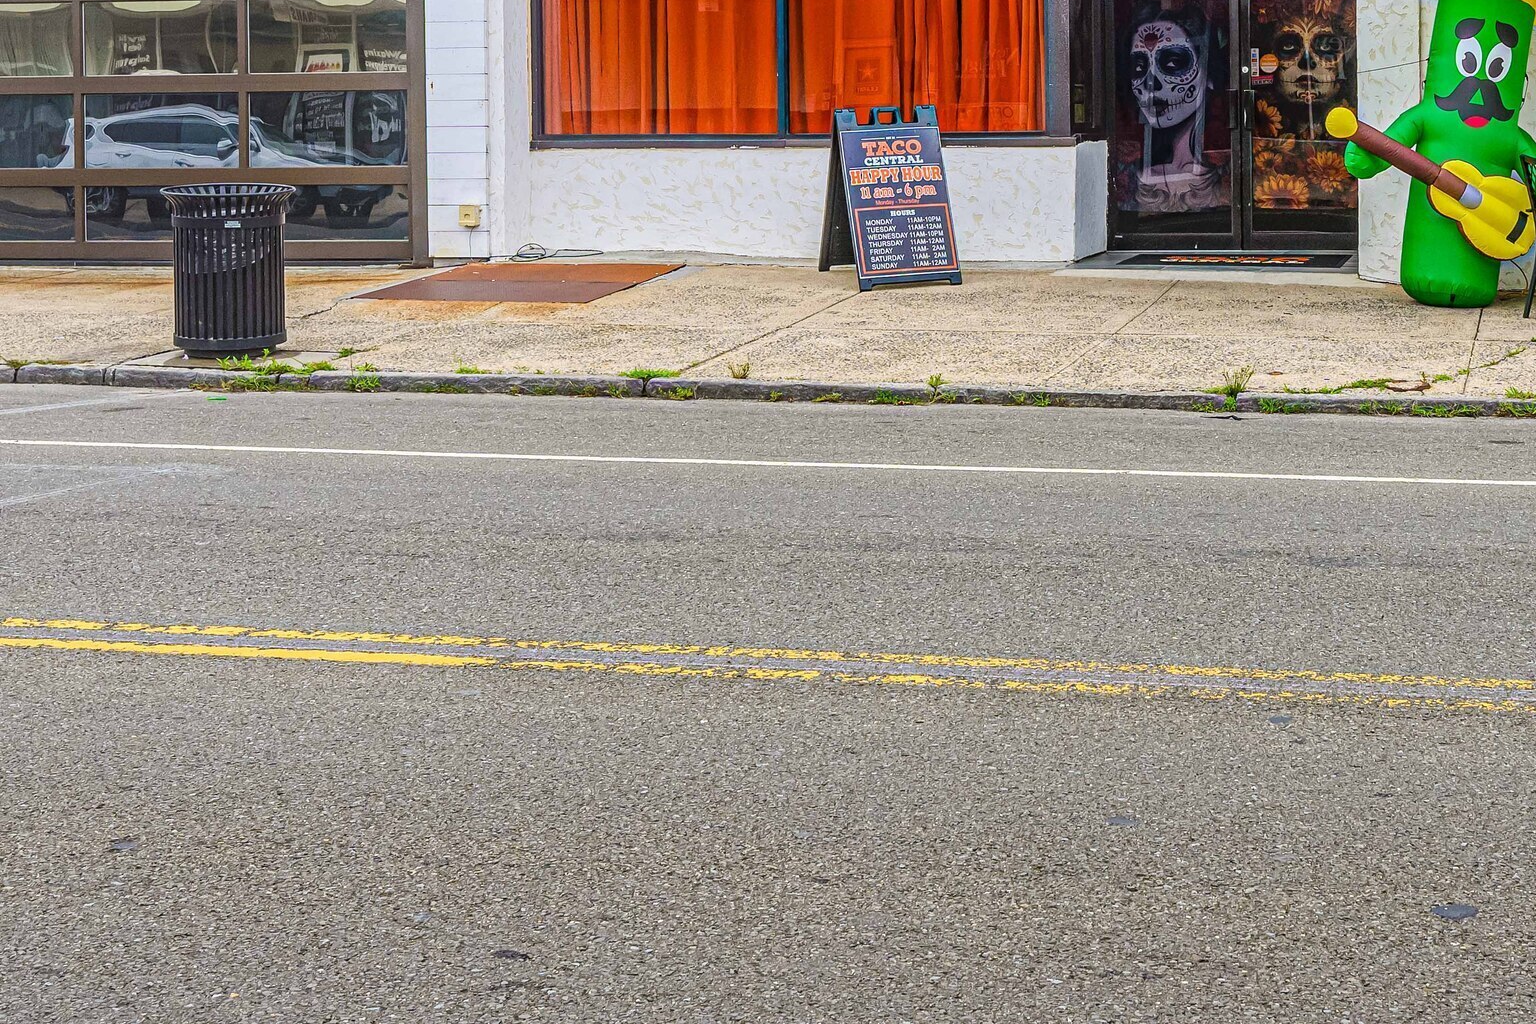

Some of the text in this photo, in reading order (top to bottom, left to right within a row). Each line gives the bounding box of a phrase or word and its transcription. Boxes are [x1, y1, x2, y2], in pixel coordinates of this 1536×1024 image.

[861, 138, 922, 157] TACO
[864, 154, 924, 166] CENTRAL
[849, 165, 943, 186] HAPPY HOUR
[860, 186, 872, 200] 11
[873, 186, 895, 198] am
[904, 182, 914, 197] 6
[914, 184, 937, 200] pm
[890, 209, 916, 217] HOURS
[865, 215, 942, 226] MONDAY 11AM-10PM
[866, 223, 943, 234] TUESDAY 11AM-12AM
[867, 230, 944, 241] WEDNESDAY 11AM-10PM
[868, 237, 945, 248] THURSDAY 11AM-12AM
[869, 247, 894, 255] FRIDAY
[870, 254, 905, 263] SATURDAY
[933, 251, 948, 259] 2AM
[871, 259, 948, 270] SUNDAY 11AM-12AM
